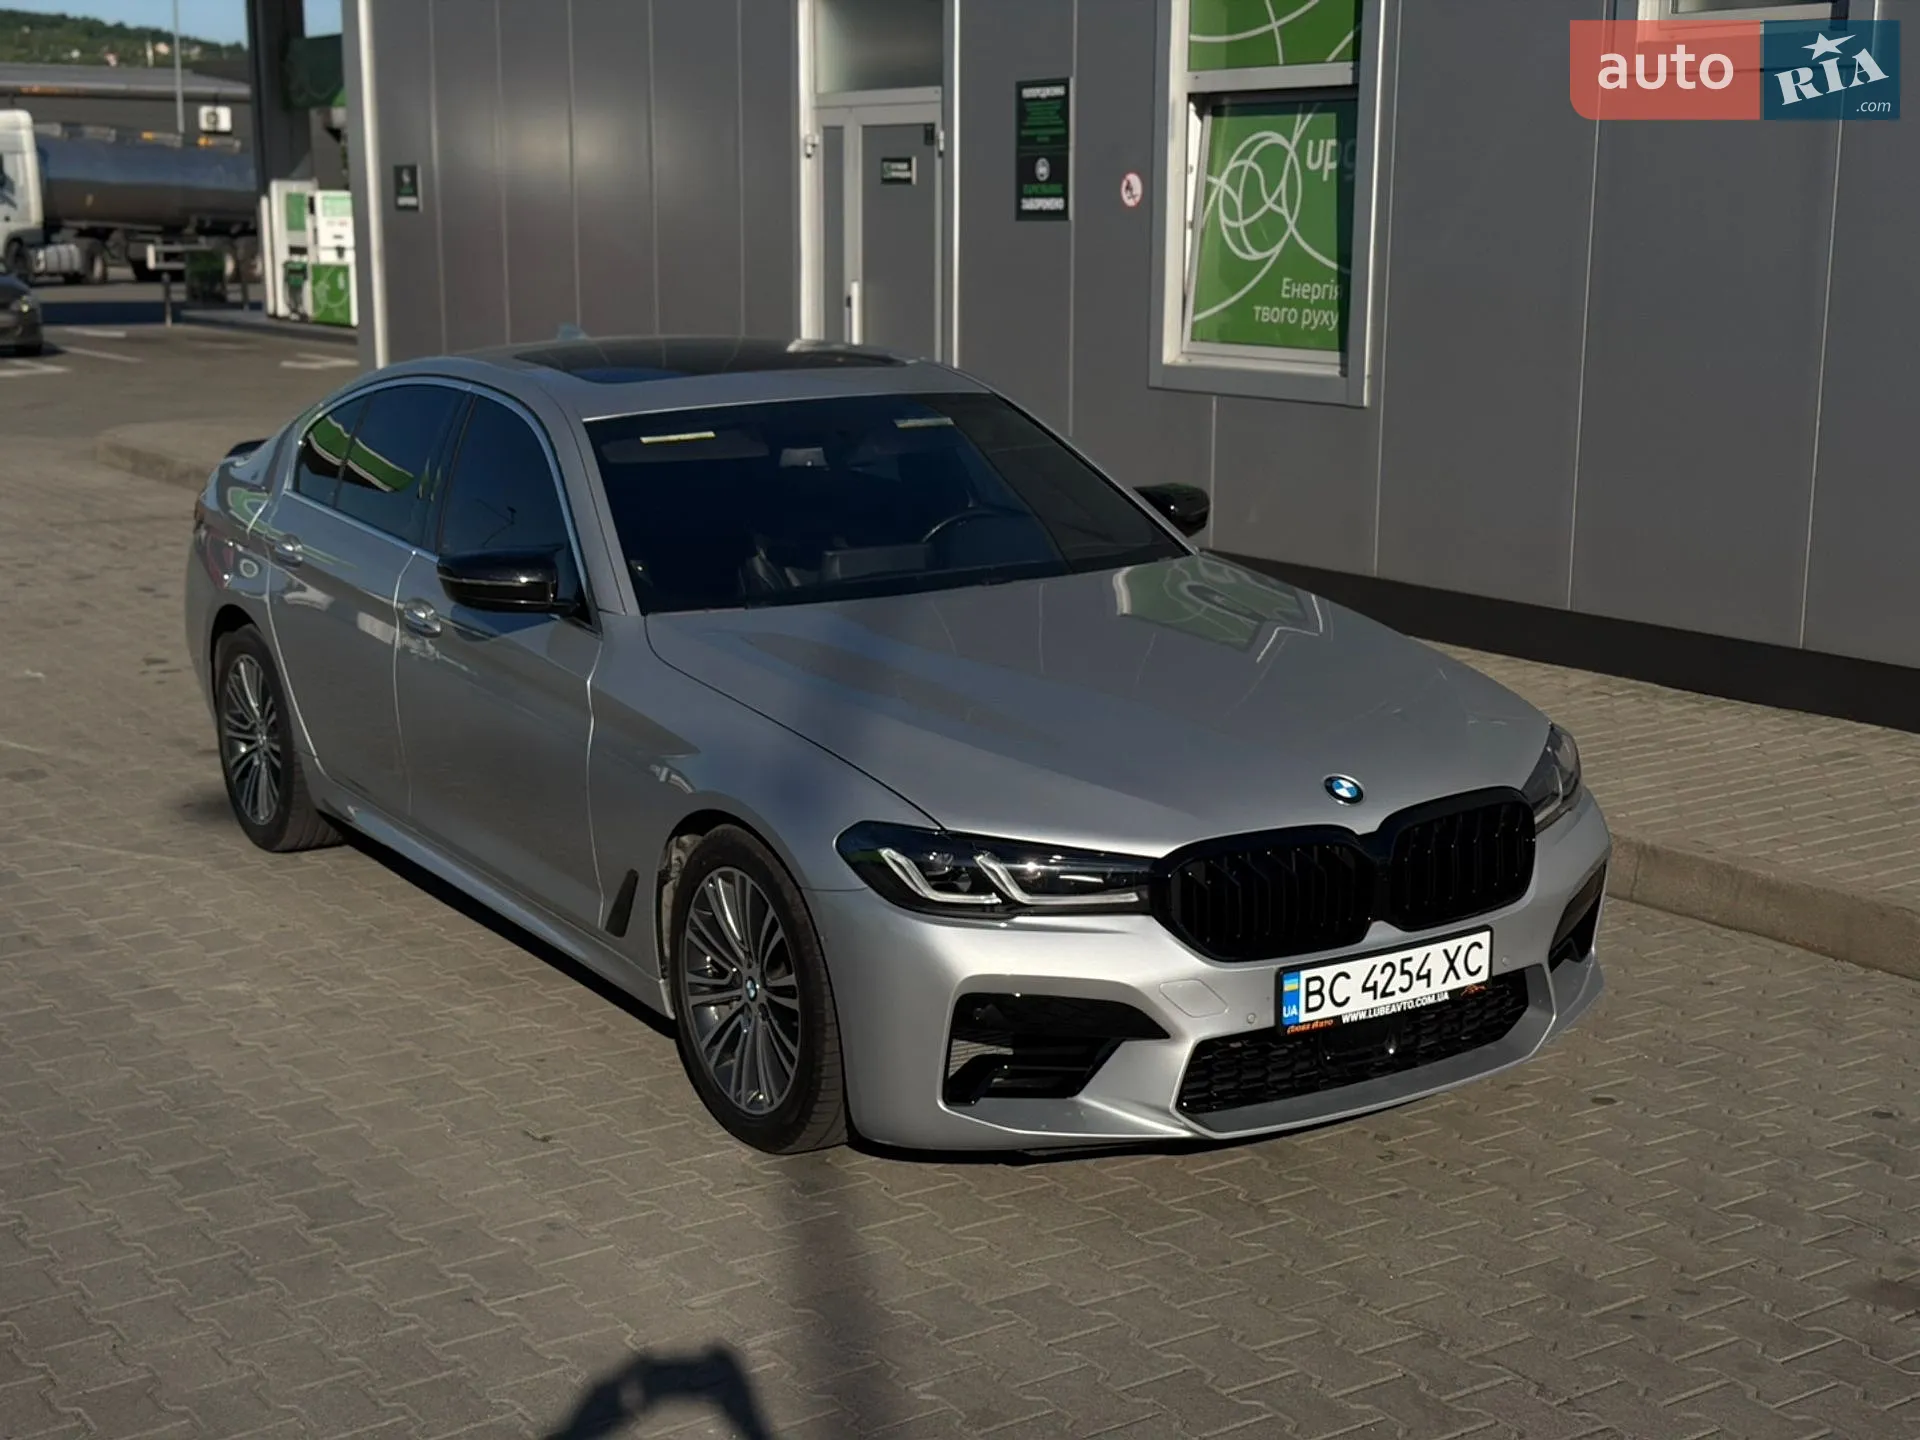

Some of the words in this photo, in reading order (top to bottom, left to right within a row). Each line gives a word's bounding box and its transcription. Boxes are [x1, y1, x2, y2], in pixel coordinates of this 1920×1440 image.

[1281, 277, 1342, 304] Енергія
[1253, 305, 1298, 323] твого
[1301, 308, 1340, 332] руху
[1305, 971, 1351, 1013] BC
[1361, 952, 1432, 1000] 4254
[1442, 941, 1483, 984] XC
[1283, 1004, 1298, 1018] UA
[1341, 991, 1450, 1024] WWW.LUBEAVTO.COM.UA
